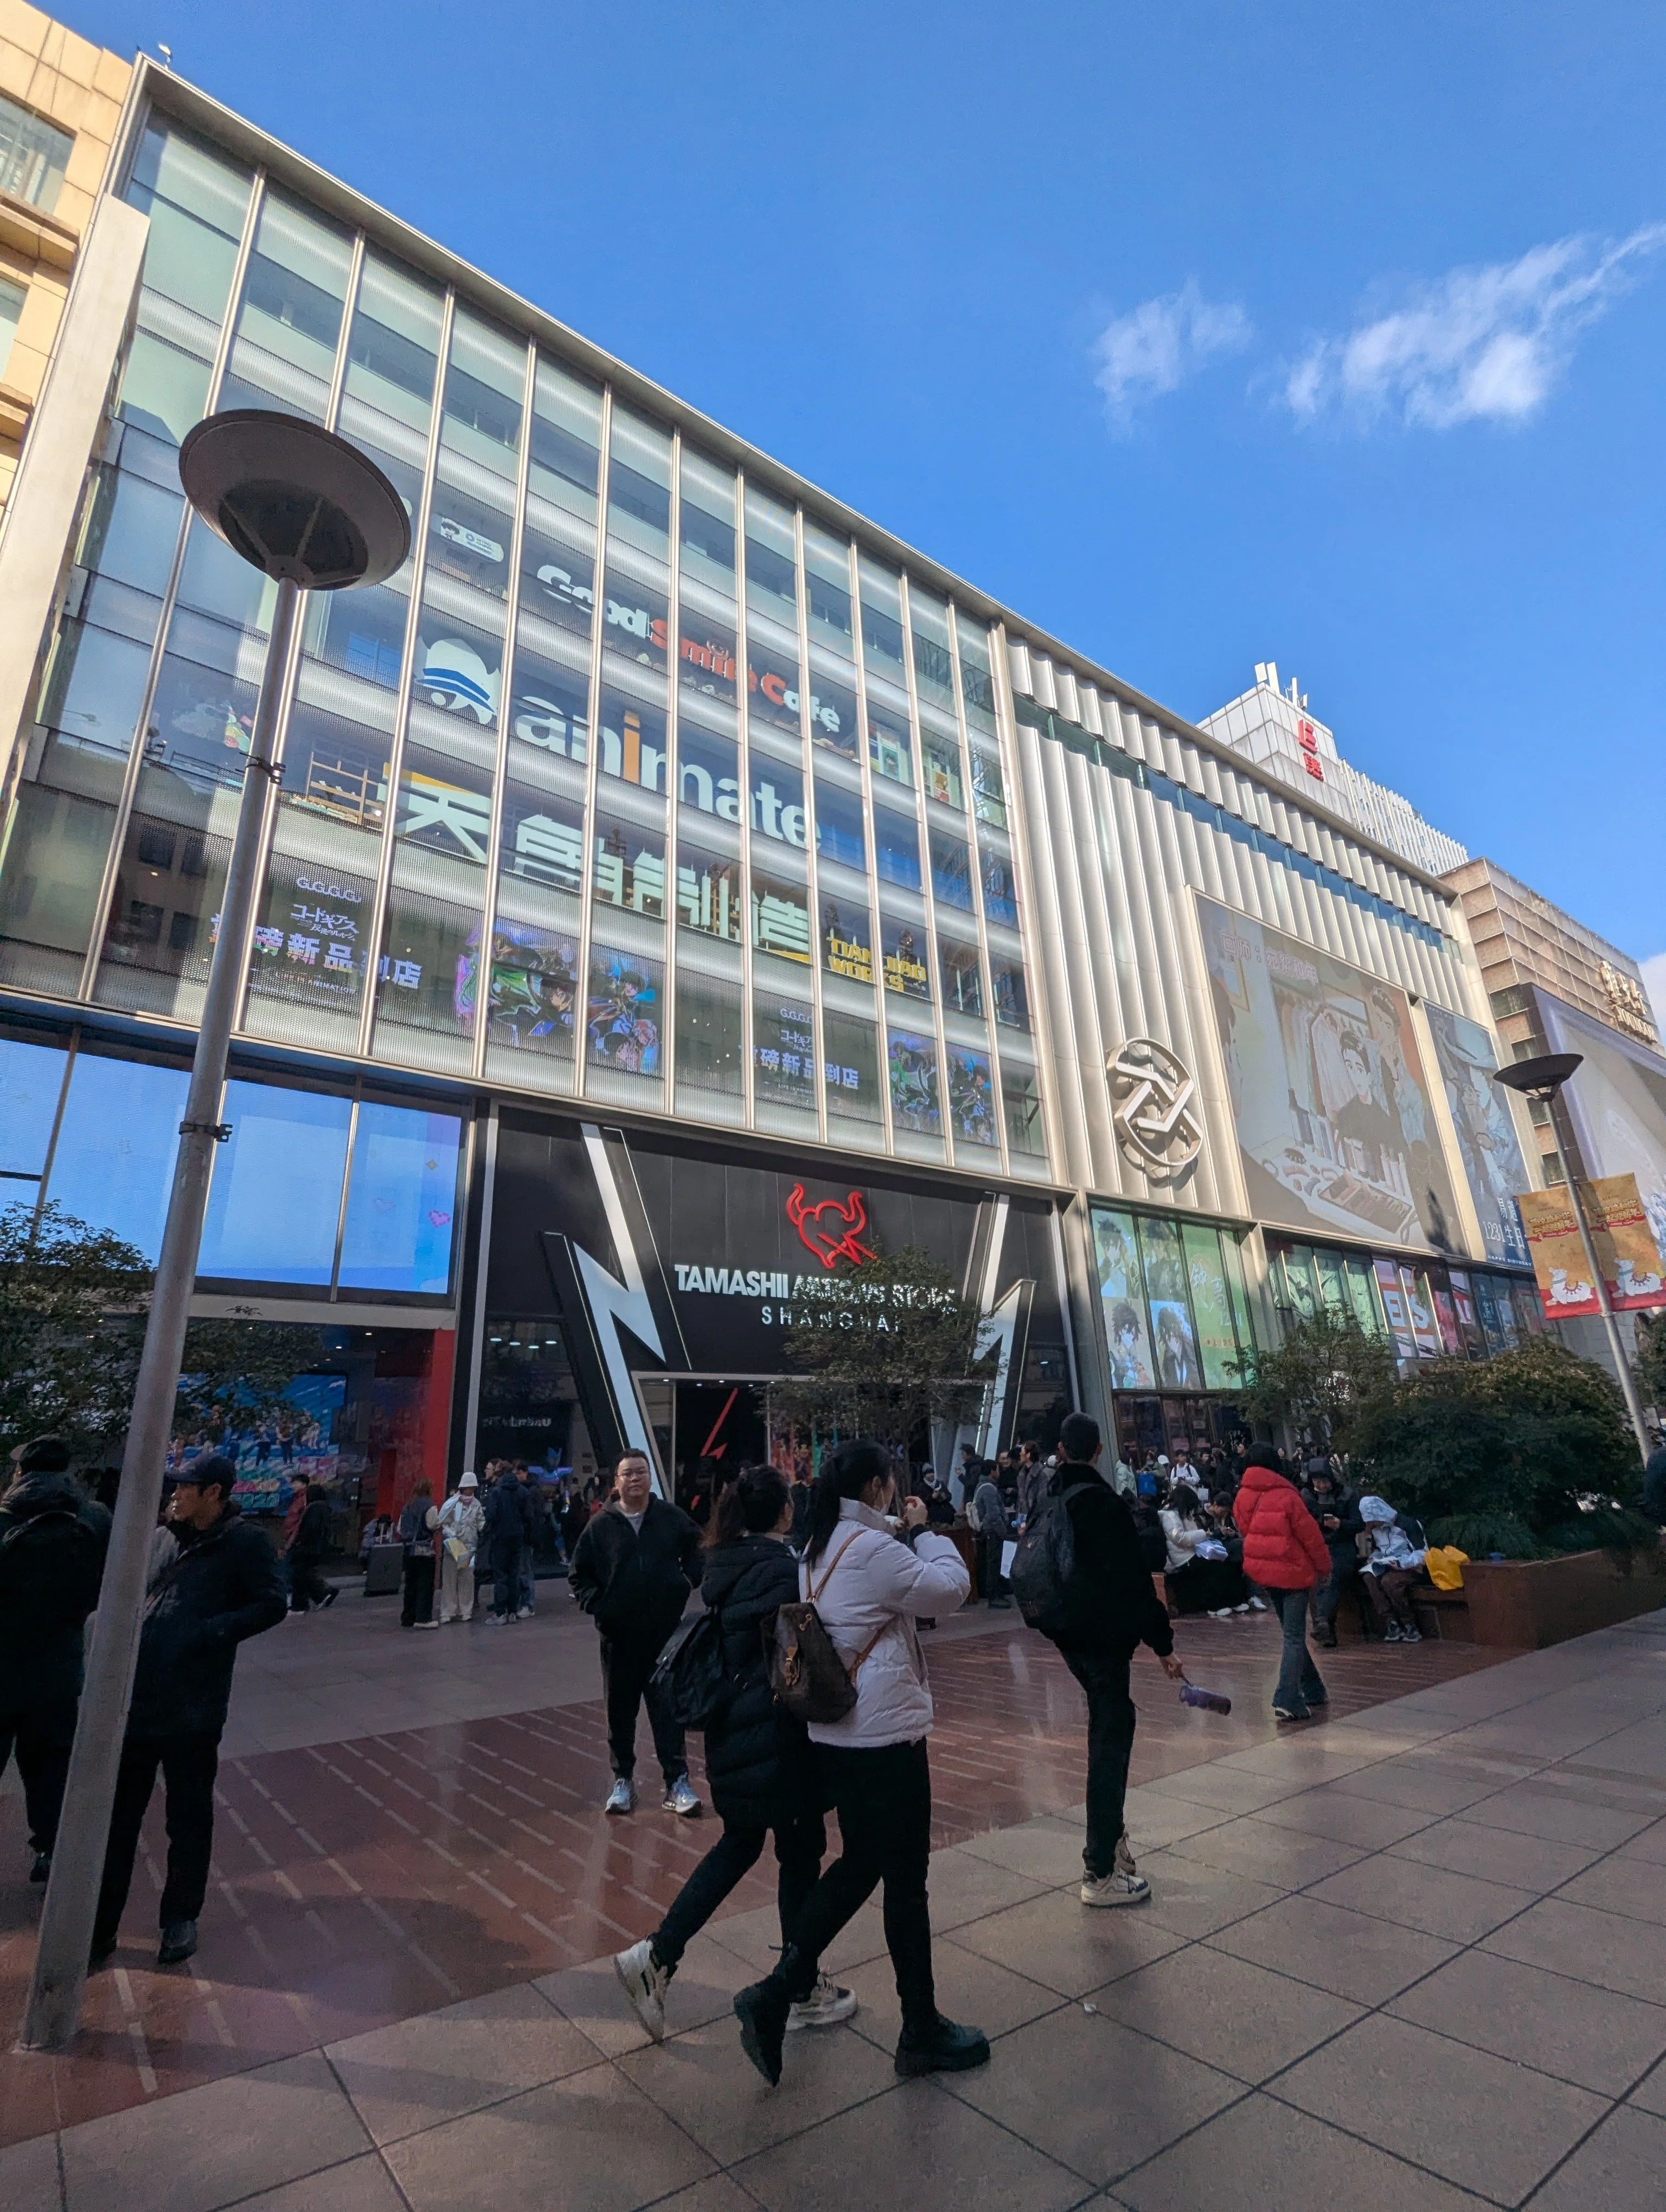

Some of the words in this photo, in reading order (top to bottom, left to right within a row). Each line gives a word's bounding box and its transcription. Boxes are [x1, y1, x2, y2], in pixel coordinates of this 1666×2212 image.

[760, 672, 841, 733] Cafe
[515, 696, 822, 851] animate
[1483, 1220, 1526, 1249] 1231生日
[674, 1264, 789, 1299] TAMASHII
